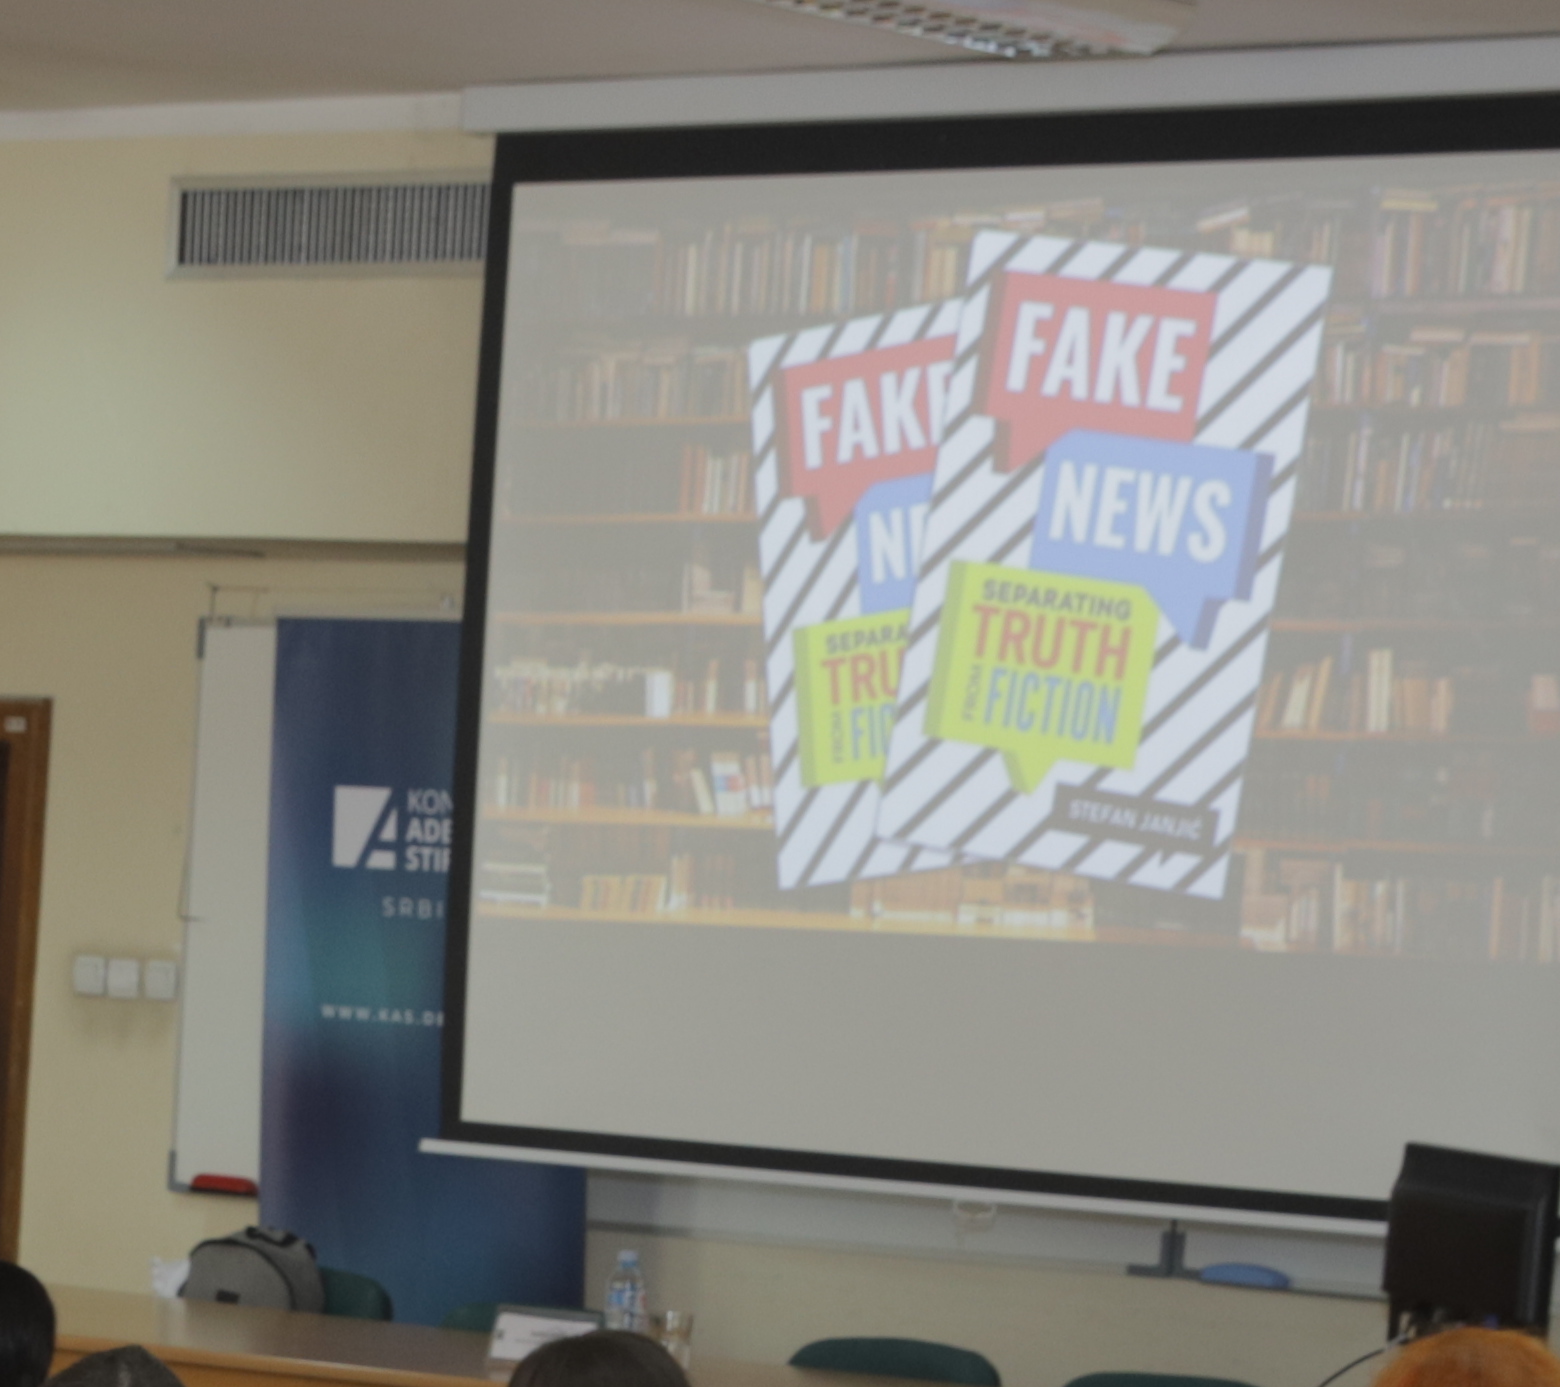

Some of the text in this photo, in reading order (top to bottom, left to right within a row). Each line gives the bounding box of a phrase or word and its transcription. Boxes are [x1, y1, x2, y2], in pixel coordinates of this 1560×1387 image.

[1005, 300, 1197, 413] FAKE
[1046, 460, 1232, 563] NEWS
[983, 578, 1132, 621] SEPARATING
[973, 604, 1132, 680] TRUTH
[821, 647, 905, 705] TRU
[962, 664, 982, 721] FROM
[983, 667, 1122, 745] FICTION
[1068, 799, 1137, 829] STEFAN
